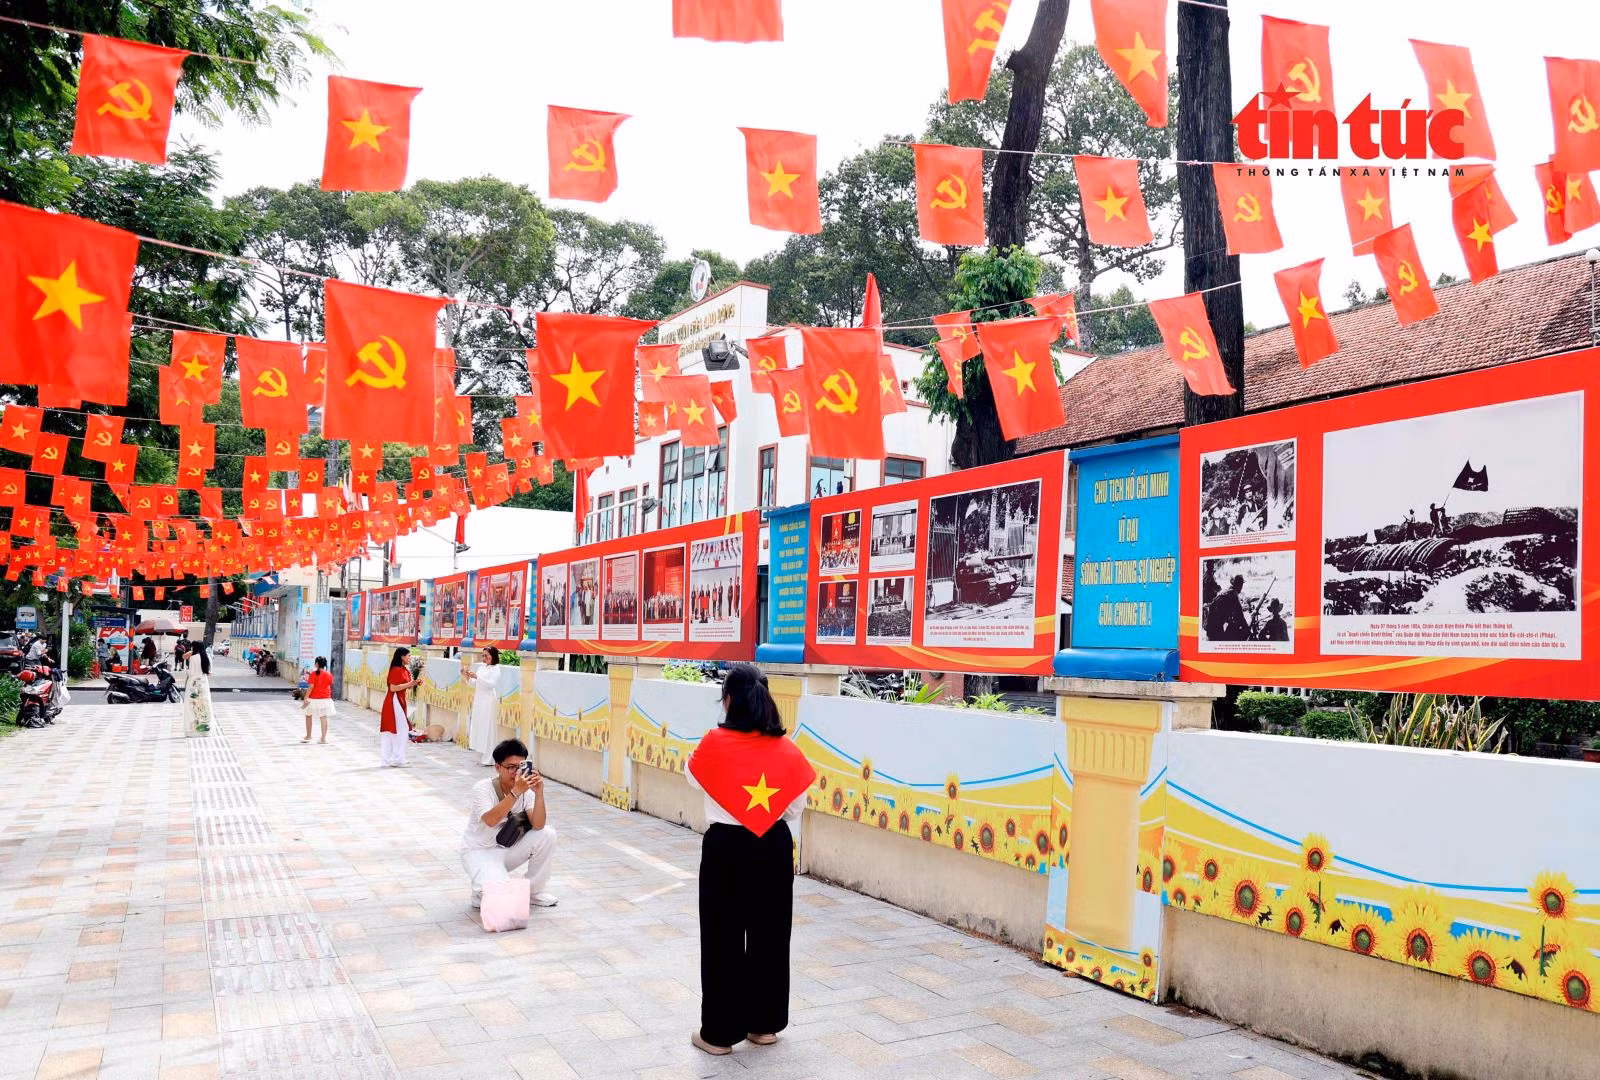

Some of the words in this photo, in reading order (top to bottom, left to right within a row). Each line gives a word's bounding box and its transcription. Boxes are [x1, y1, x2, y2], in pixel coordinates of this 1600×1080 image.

[1094, 472, 1107, 504] CHỦ
[1110, 478, 1124, 508] TỊCH
[1126, 467, 1134, 500] HỒ
[1137, 469, 1148, 499] CHÍ
[1150, 471, 1169, 497] MINH
[1127, 518, 1138, 547] ĐẠI
[1081, 555, 1098, 585] SỐNG
[1100, 556, 1112, 585] MÃI
[1115, 560, 1137, 584] TRONG
[1138, 557, 1149, 589] SỰ
[1150, 552, 1176, 588] NGHIỆP
[1099, 595, 1112, 625] CỦA
[1114, 596, 1137, 625] CHÚNG
